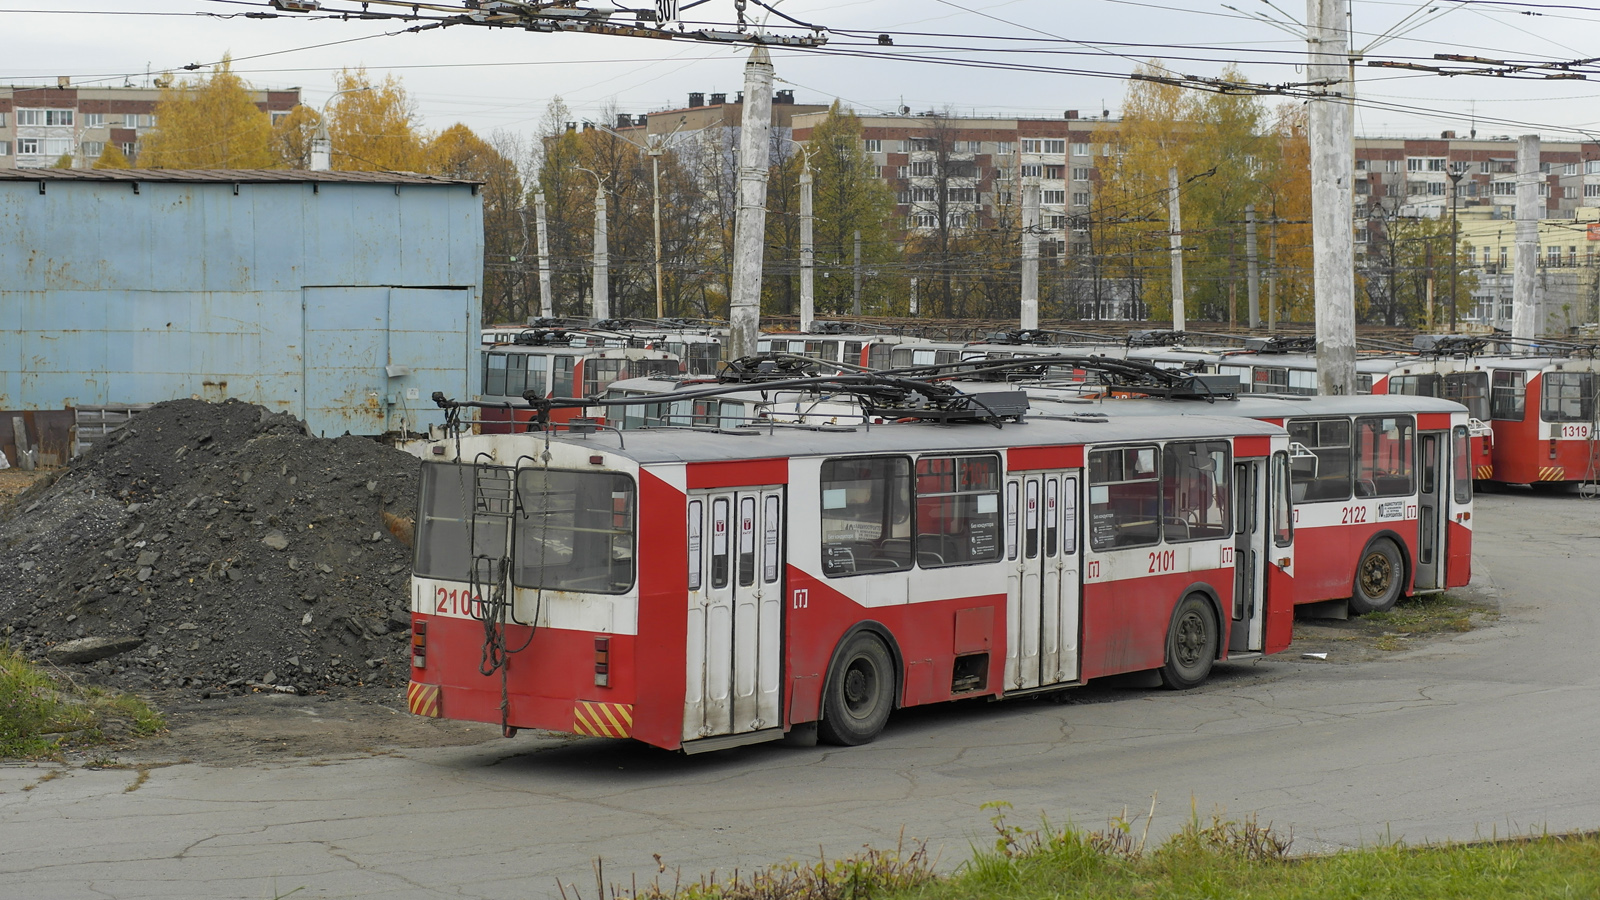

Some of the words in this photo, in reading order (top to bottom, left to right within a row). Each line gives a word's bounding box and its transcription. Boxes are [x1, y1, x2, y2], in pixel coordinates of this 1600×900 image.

[655, 0, 676, 23] 307
[1332, 384, 1343, 396] 31
[1562, 426, 1588, 437] 1319
[961, 463, 989, 485] 2101
[1342, 506, 1366, 524] 2122
[1148, 549, 1175, 573] 2101
[437, 587, 481, 618] 2101
